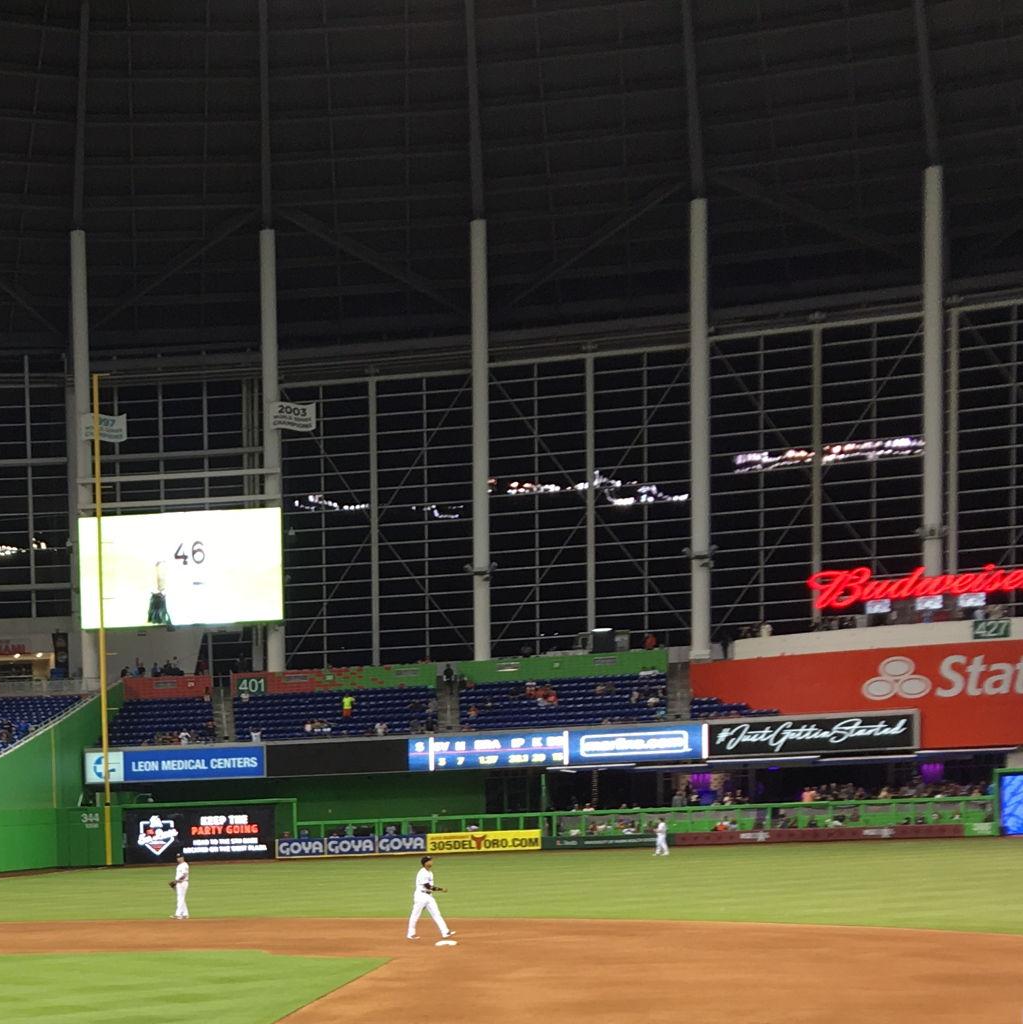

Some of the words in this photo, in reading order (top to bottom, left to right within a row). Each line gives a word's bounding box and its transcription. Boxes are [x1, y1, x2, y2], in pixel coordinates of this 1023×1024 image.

[278, 404, 307, 417] 2003
[174, 541, 205, 565] 46
[976, 621, 1010, 637] 427
[238, 679, 265, 693] 401
[132, 760, 159, 772] LEON
[161, 759, 208, 771] MEDICAL
[210, 757, 258, 769] CENTERS
[200, 815, 226, 825] KEEP
[228, 814, 248, 825] THE
[191, 826, 223, 835] PARTY
[226, 824, 259, 834] GOING
[280, 840, 324, 857] GOYA
[328, 838, 374, 855] GOYA
[378, 836, 425, 852] GOYA
